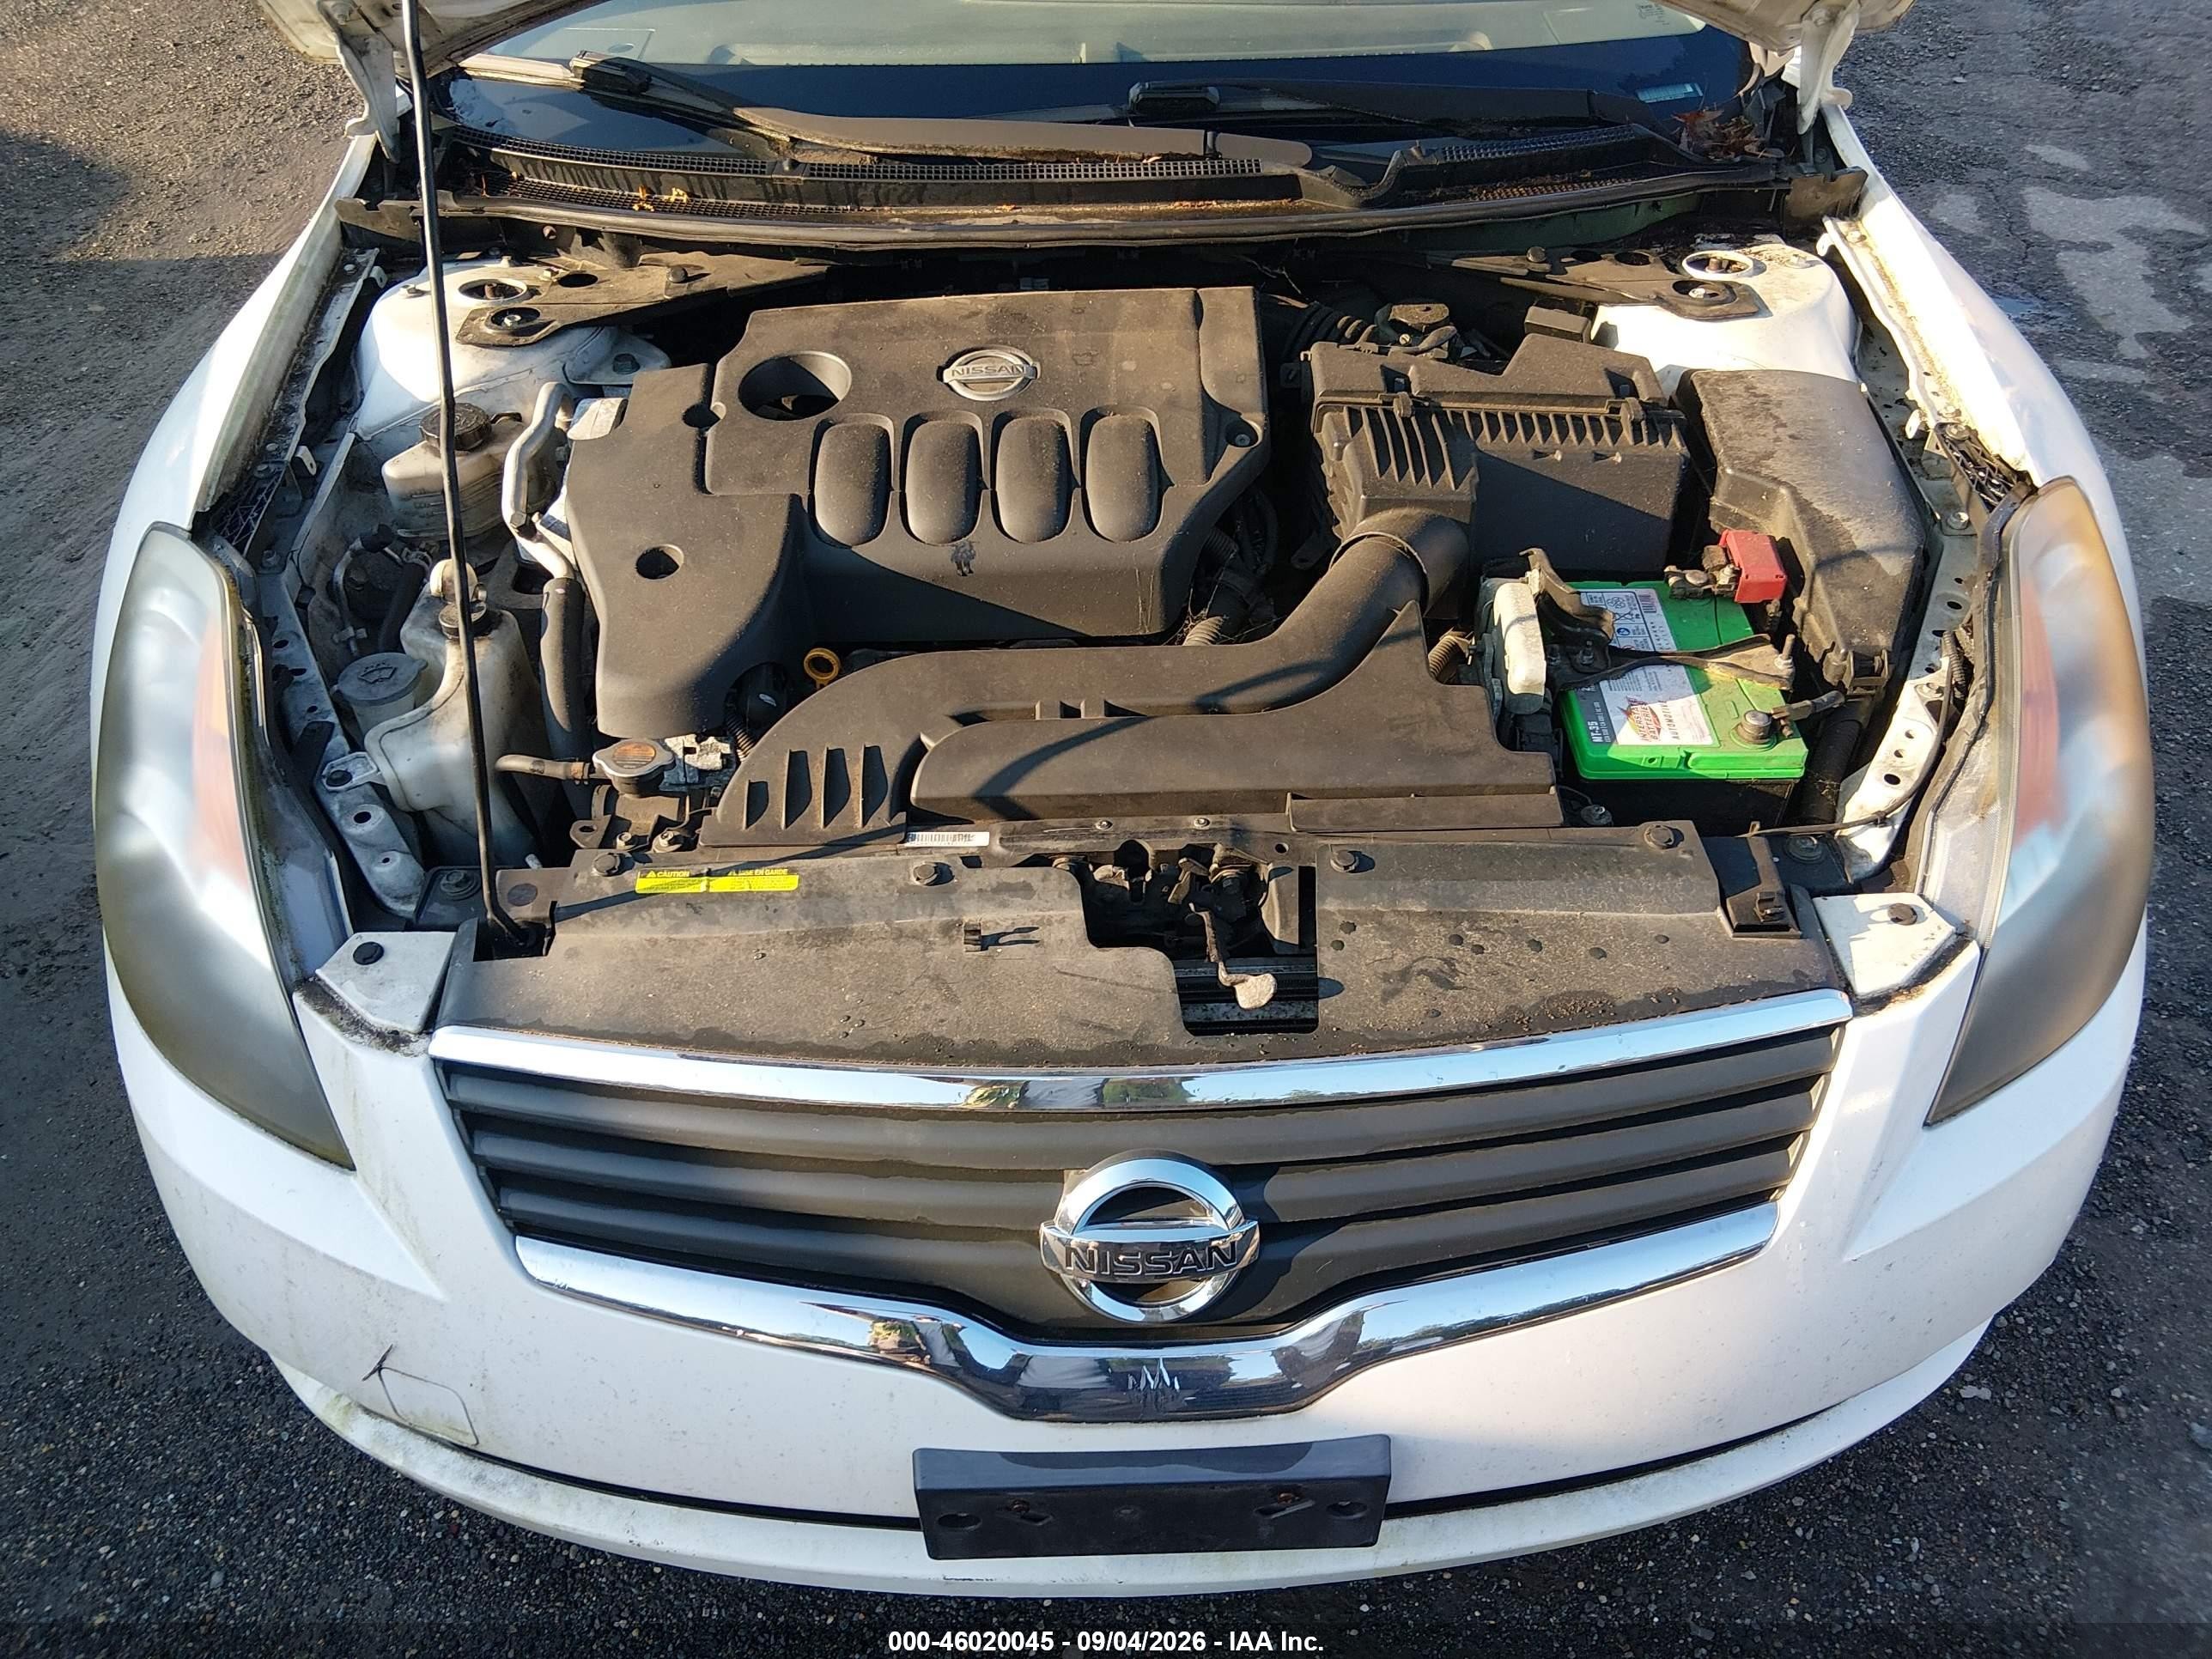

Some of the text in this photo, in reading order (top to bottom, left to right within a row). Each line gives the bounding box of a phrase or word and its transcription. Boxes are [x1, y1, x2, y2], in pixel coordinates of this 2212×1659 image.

[951, 364, 1025, 377] NISSAN
[1587, 720, 1603, 743] MT-35
[1657, 700, 1680, 740] AUTOMOTIVE
[1065, 1241, 1239, 1277] NISSAN
